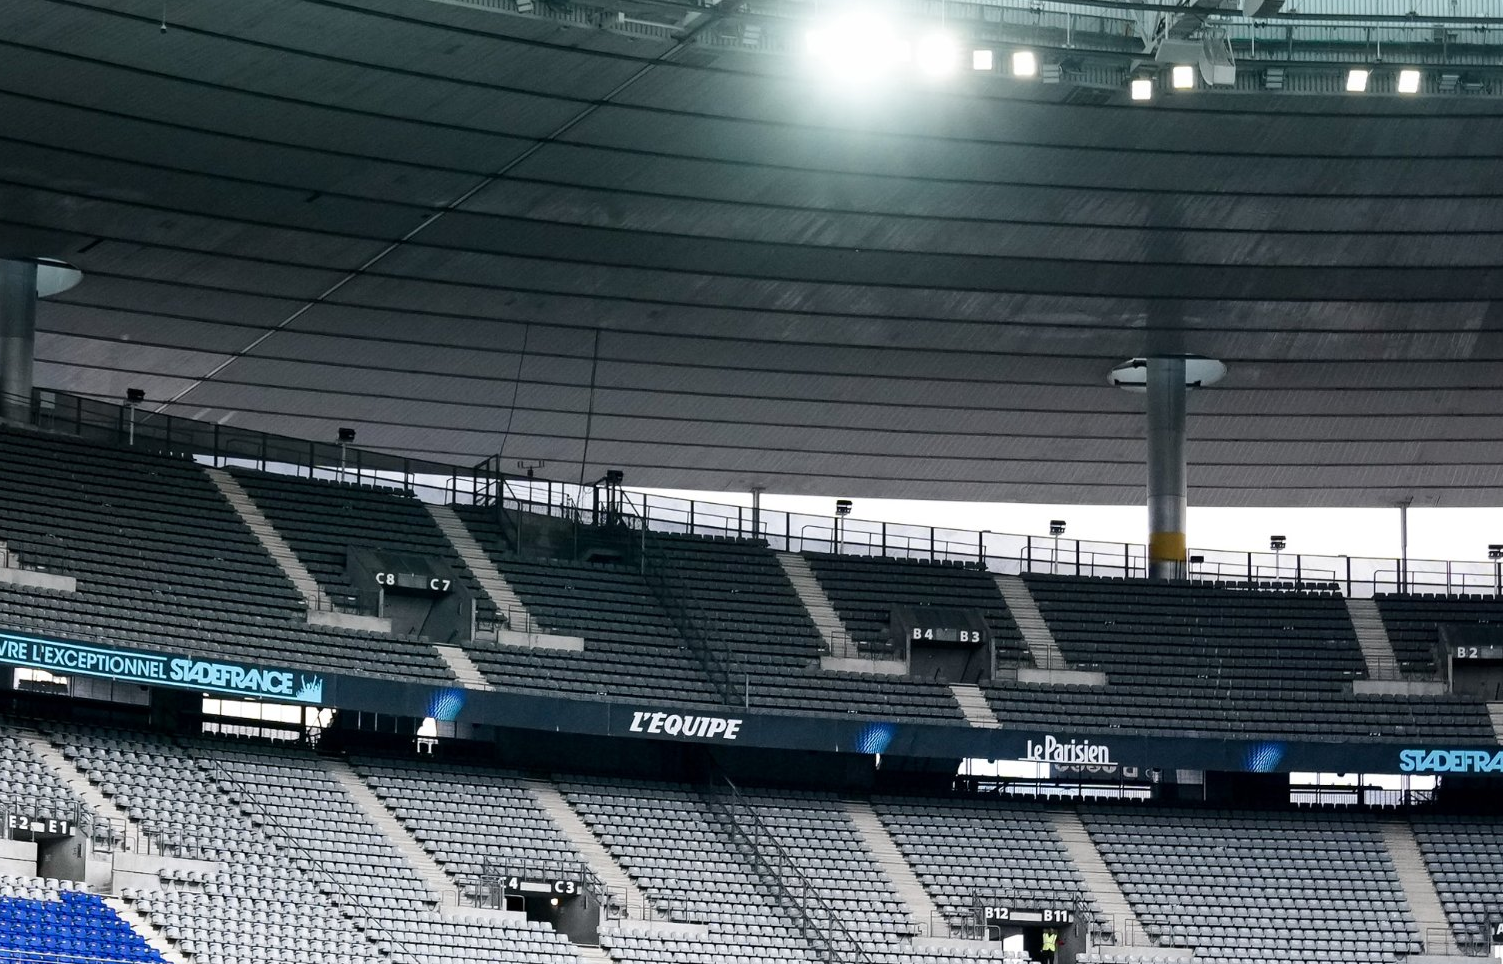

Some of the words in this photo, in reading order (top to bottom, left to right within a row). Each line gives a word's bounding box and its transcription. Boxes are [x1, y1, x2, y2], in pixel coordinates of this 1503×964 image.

[375, 572, 395, 585] C8
[430, 578, 451, 591] C7
[912, 628, 934, 640] B4
[960, 630, 980, 643] B3
[1457, 646, 1478, 659] B2
[31, 645, 167, 680] L'EXCEPTIONNEL
[169, 659, 294, 694] STADEFRANCE
[1027, 739, 1043, 760] Le
[1044, 735, 1110, 763] Parisien
[9, 815, 29, 830] E2
[49, 819, 67, 834] E1
[554, 881, 575, 894] C3
[984, 906, 1009, 919] B12
[1043, 909, 1068, 922] B11
